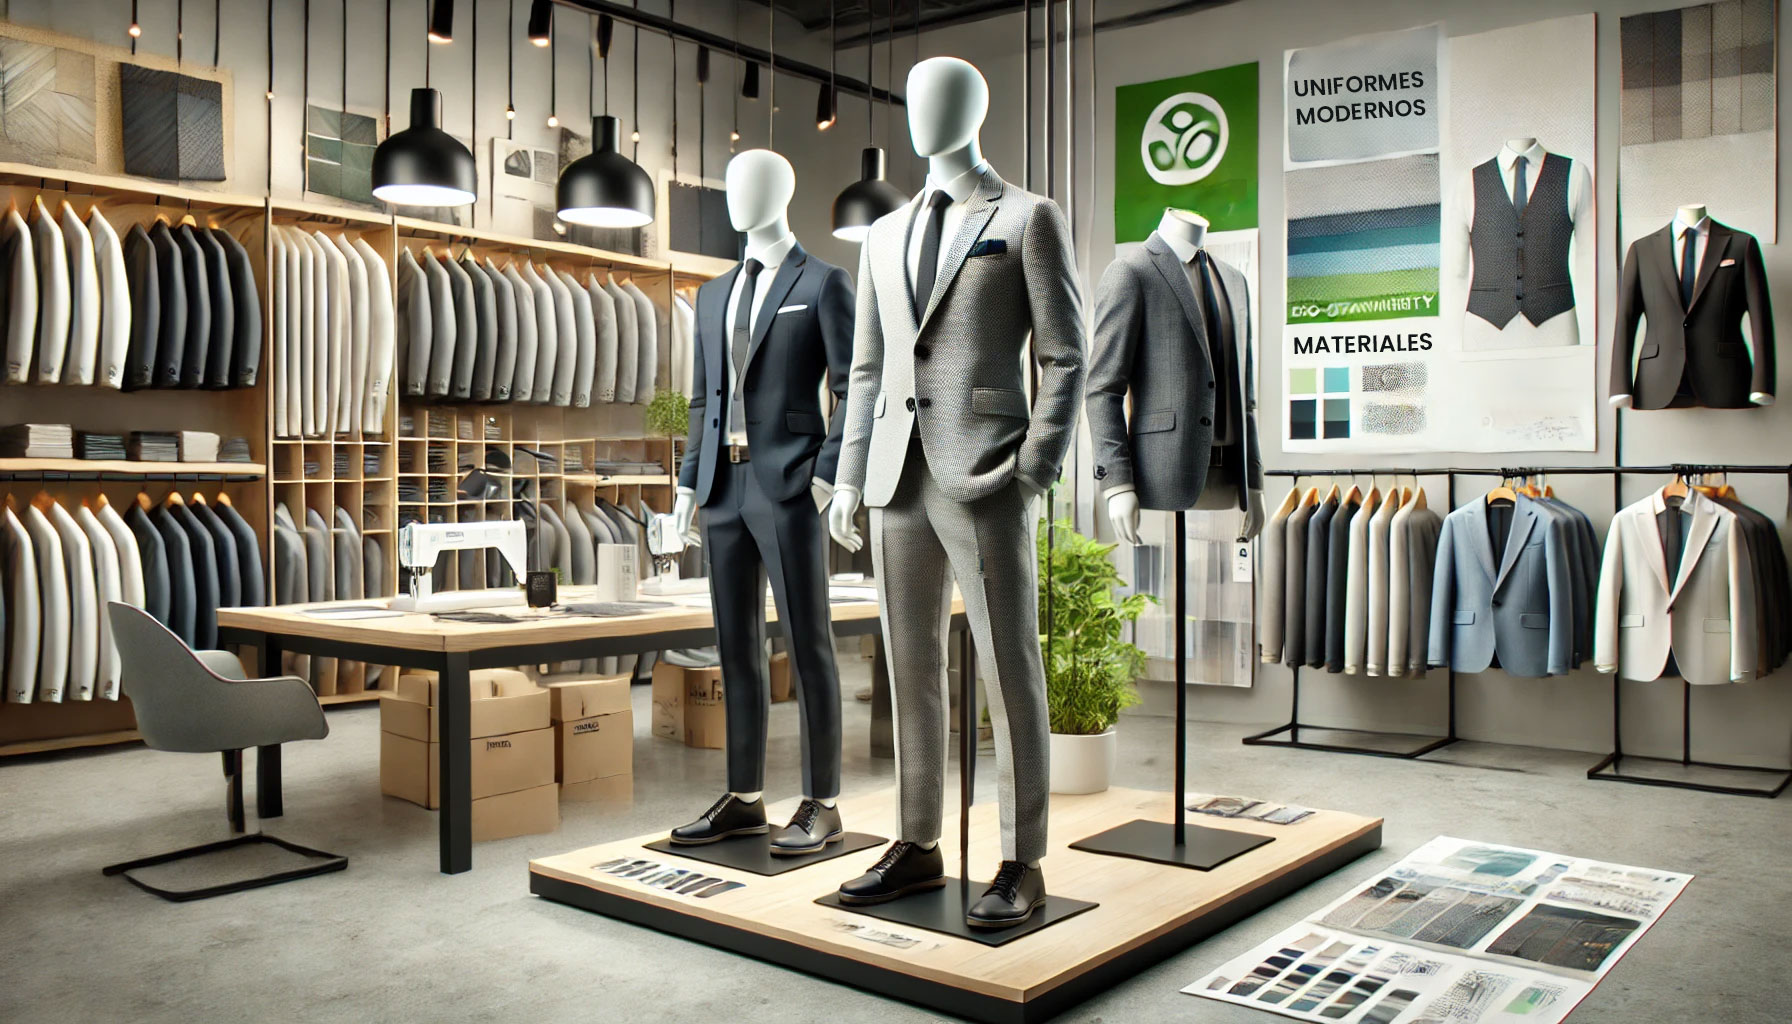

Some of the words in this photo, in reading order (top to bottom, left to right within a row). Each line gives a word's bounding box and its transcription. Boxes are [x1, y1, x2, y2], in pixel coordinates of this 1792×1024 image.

[1294, 71, 1425, 97] UNIFORMES
[1296, 99, 1427, 125] MODERNOS
[1293, 332, 1433, 355] MATERIALES
